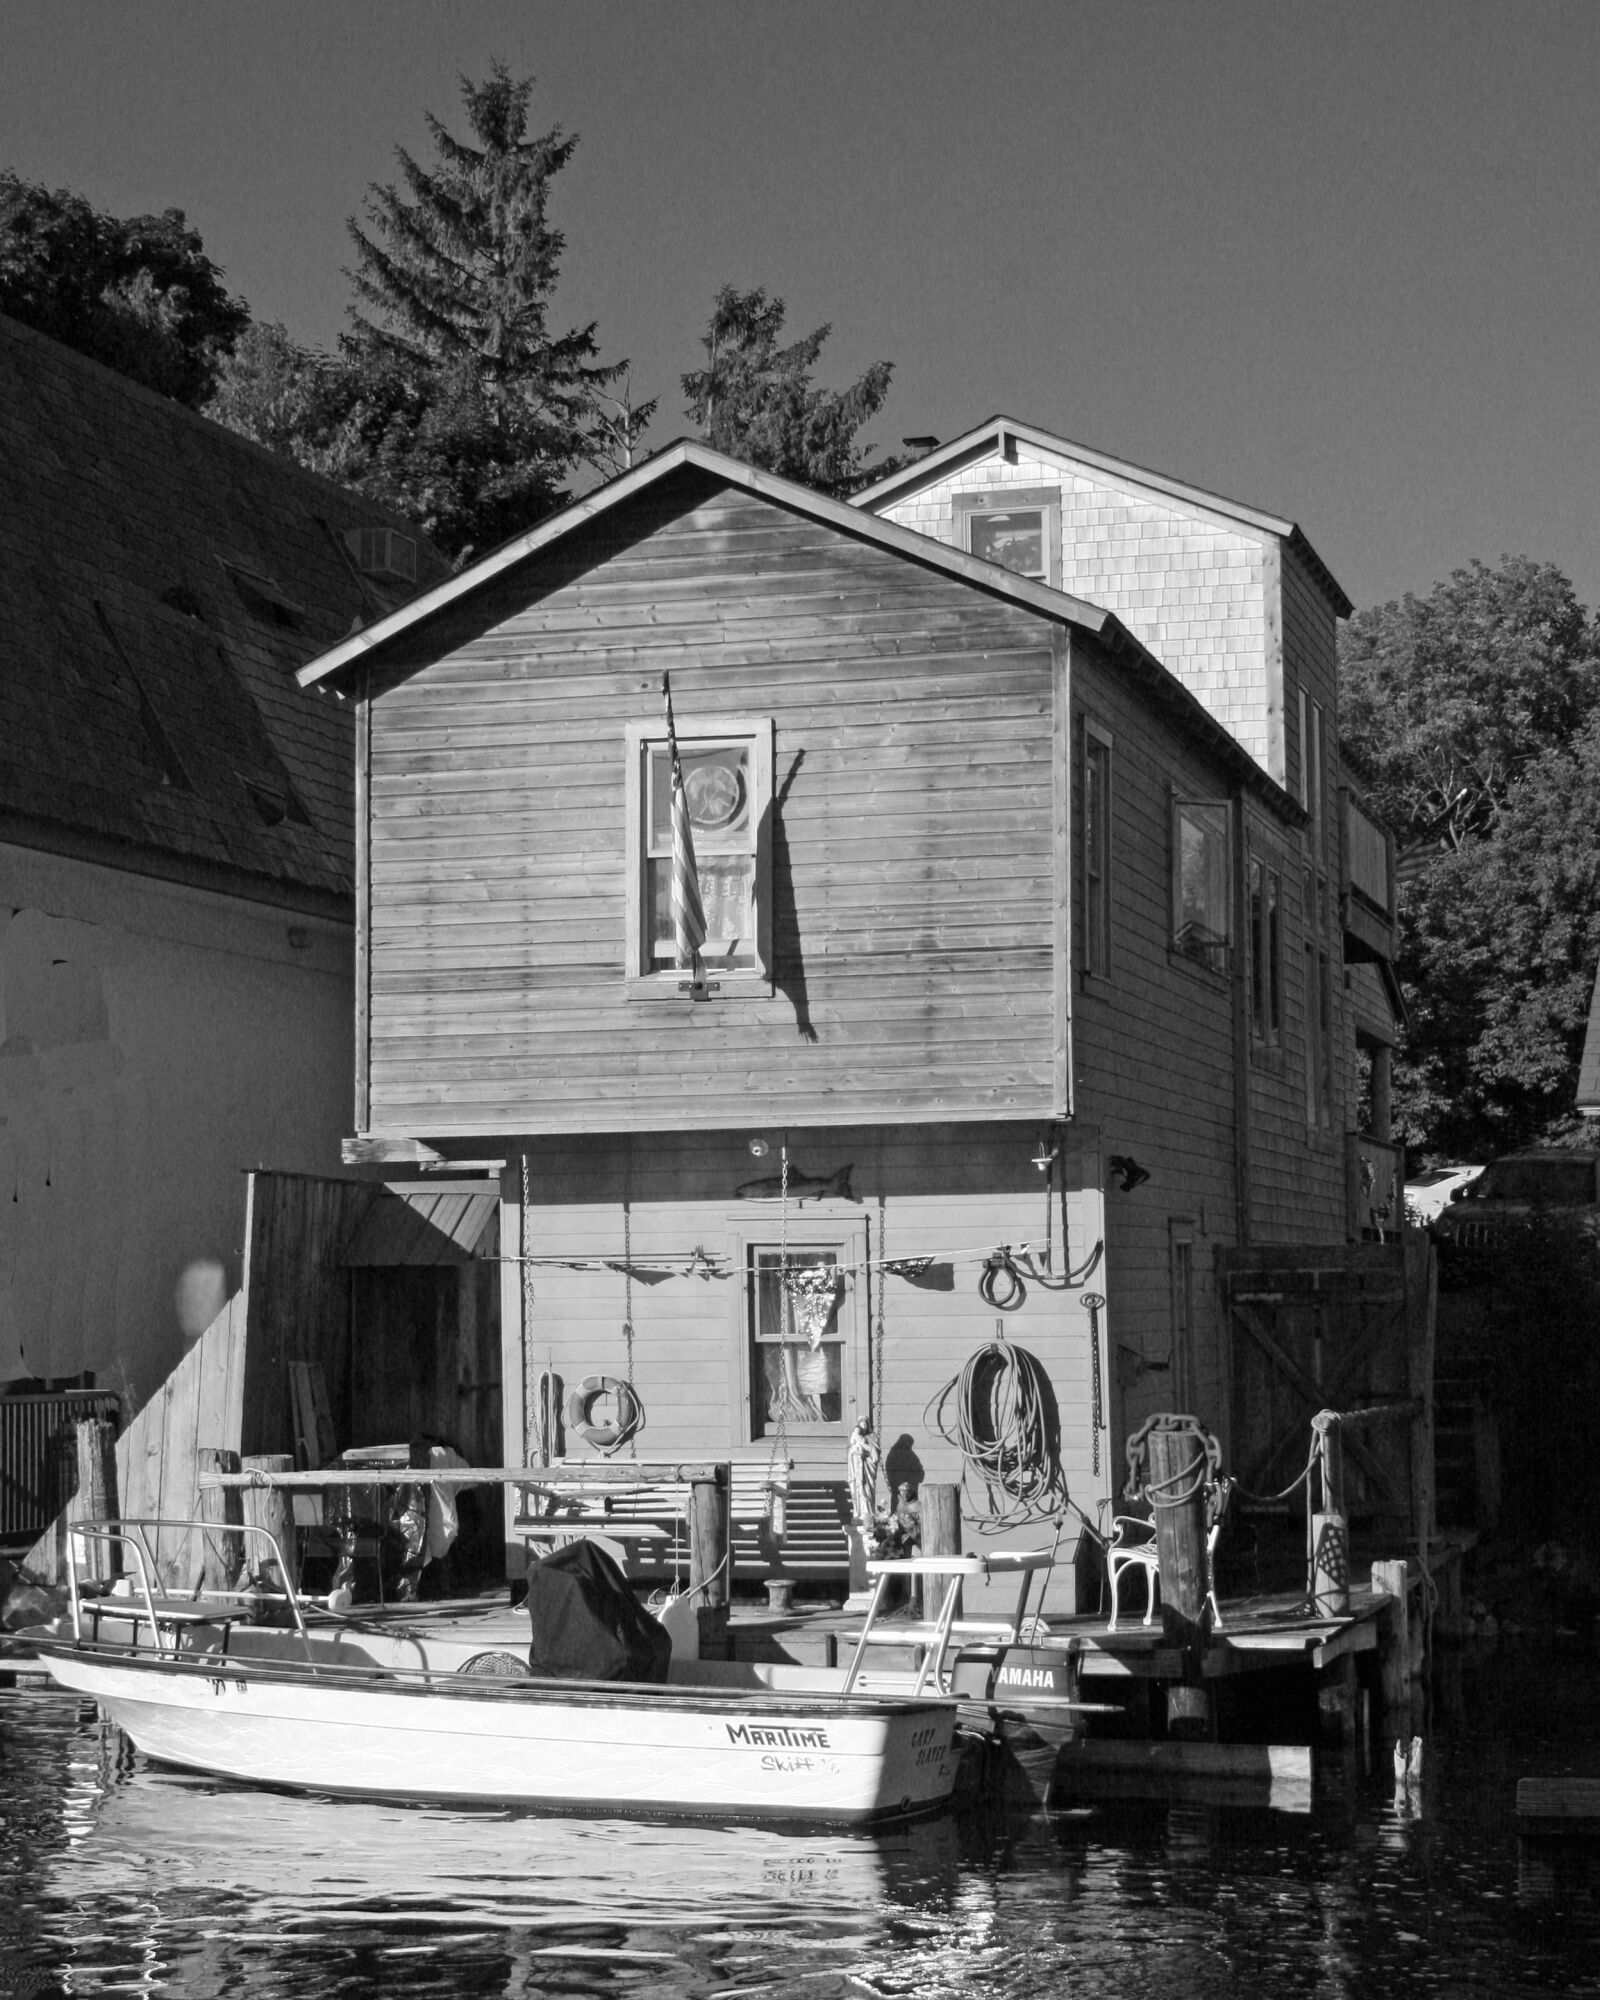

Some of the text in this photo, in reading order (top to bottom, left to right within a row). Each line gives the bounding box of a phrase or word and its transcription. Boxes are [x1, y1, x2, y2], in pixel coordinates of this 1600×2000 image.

[990, 1666, 1054, 1689] YAMAHA
[725, 1723, 831, 1749] MARITIME
[760, 1755, 815, 1772] Skiff
